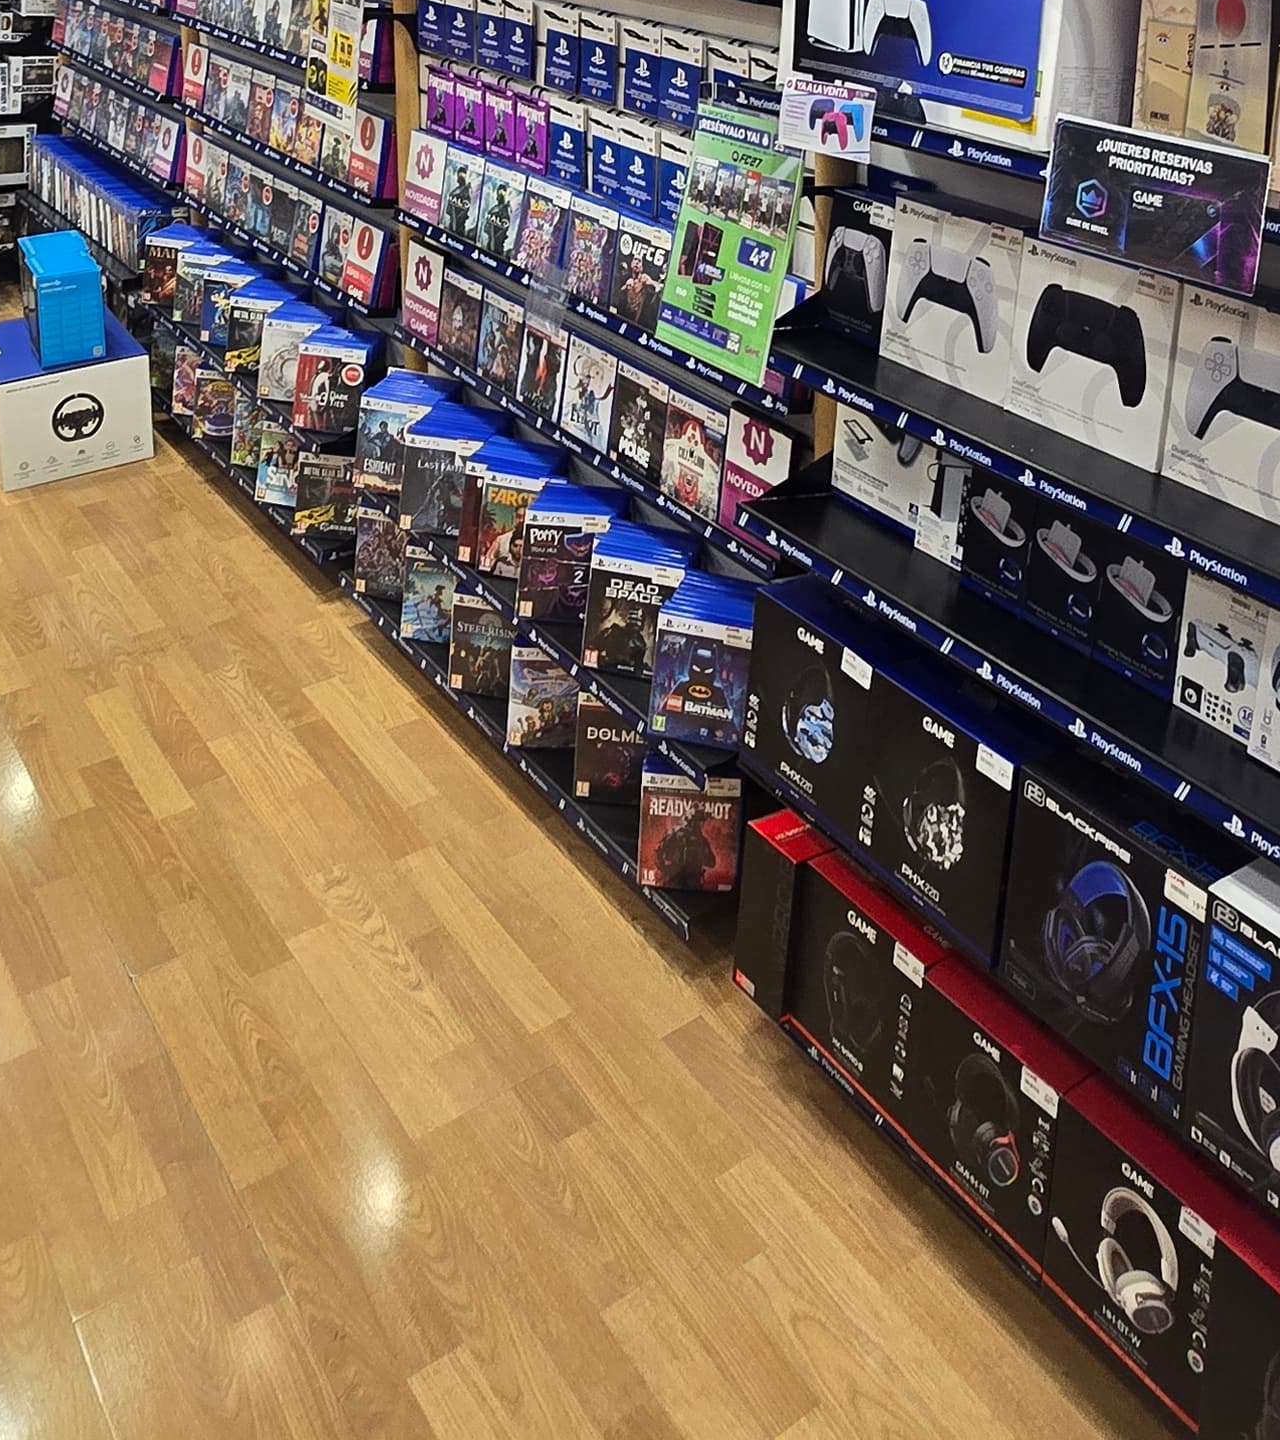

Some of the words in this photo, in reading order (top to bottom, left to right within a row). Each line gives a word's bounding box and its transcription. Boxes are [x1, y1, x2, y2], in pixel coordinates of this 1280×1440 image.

[746, 130, 761, 143] YA!
[1096, 138, 1150, 159] ¿QUIERES
[1151, 149, 1213, 174] RESERVAS
[1108, 156, 1195, 186] PRIORITARIAS?
[1133, 191, 1163, 207] GAME
[488, 215, 509, 227] HALO
[632, 242, 656, 260] UFC
[655, 250, 664, 265] 6
[329, 392, 348, 404] DARK
[619, 439, 651, 464] MOUSE
[572, 572, 583, 583] 2
[610, 579, 659, 595] DEAD
[606, 589, 662, 605] SPACE
[684, 701, 733, 719] BATMAN
[922, 715, 956, 749] GAME
[1045, 795, 1132, 864] BLACKFIRE
[1143, 906, 1189, 1081] BFX-15
[1121, 1163, 1155, 1200] GAME
